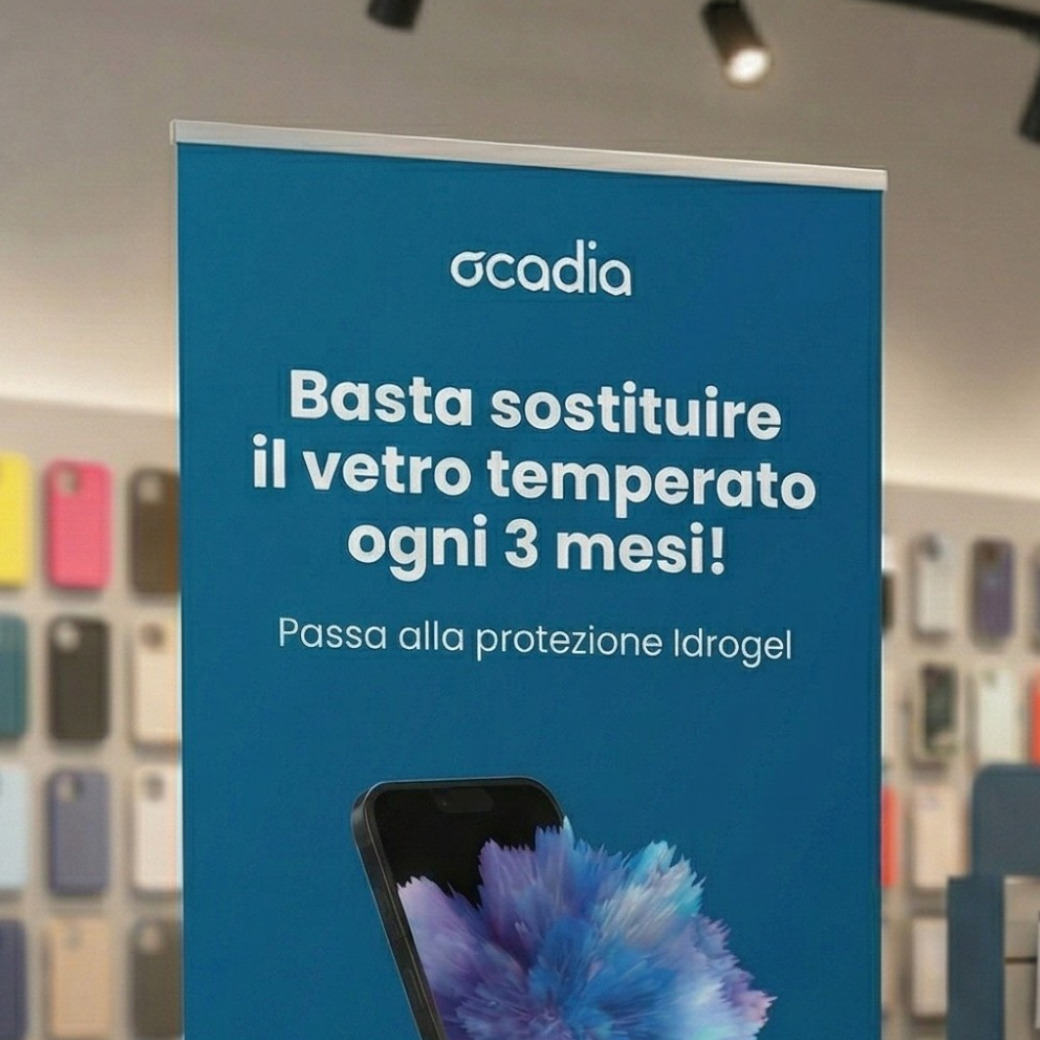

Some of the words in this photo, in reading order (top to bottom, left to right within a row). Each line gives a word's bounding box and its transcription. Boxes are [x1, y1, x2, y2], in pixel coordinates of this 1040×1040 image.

[290, 369, 472, 426] Basta
[490, 380, 782, 441] sostituire
[252, 433, 286, 489] il
[302, 446, 472, 497] vetro
[486, 450, 817, 519] temperato
[347, 513, 488, 582] ogni
[504, 518, 539, 569] 3
[556, 521, 725, 576] mesi!
[278, 616, 387, 650] Passa
[398, 620, 464, 651] alla
[475, 623, 663, 663] protezione
[673, 627, 791, 669] Idrogel
